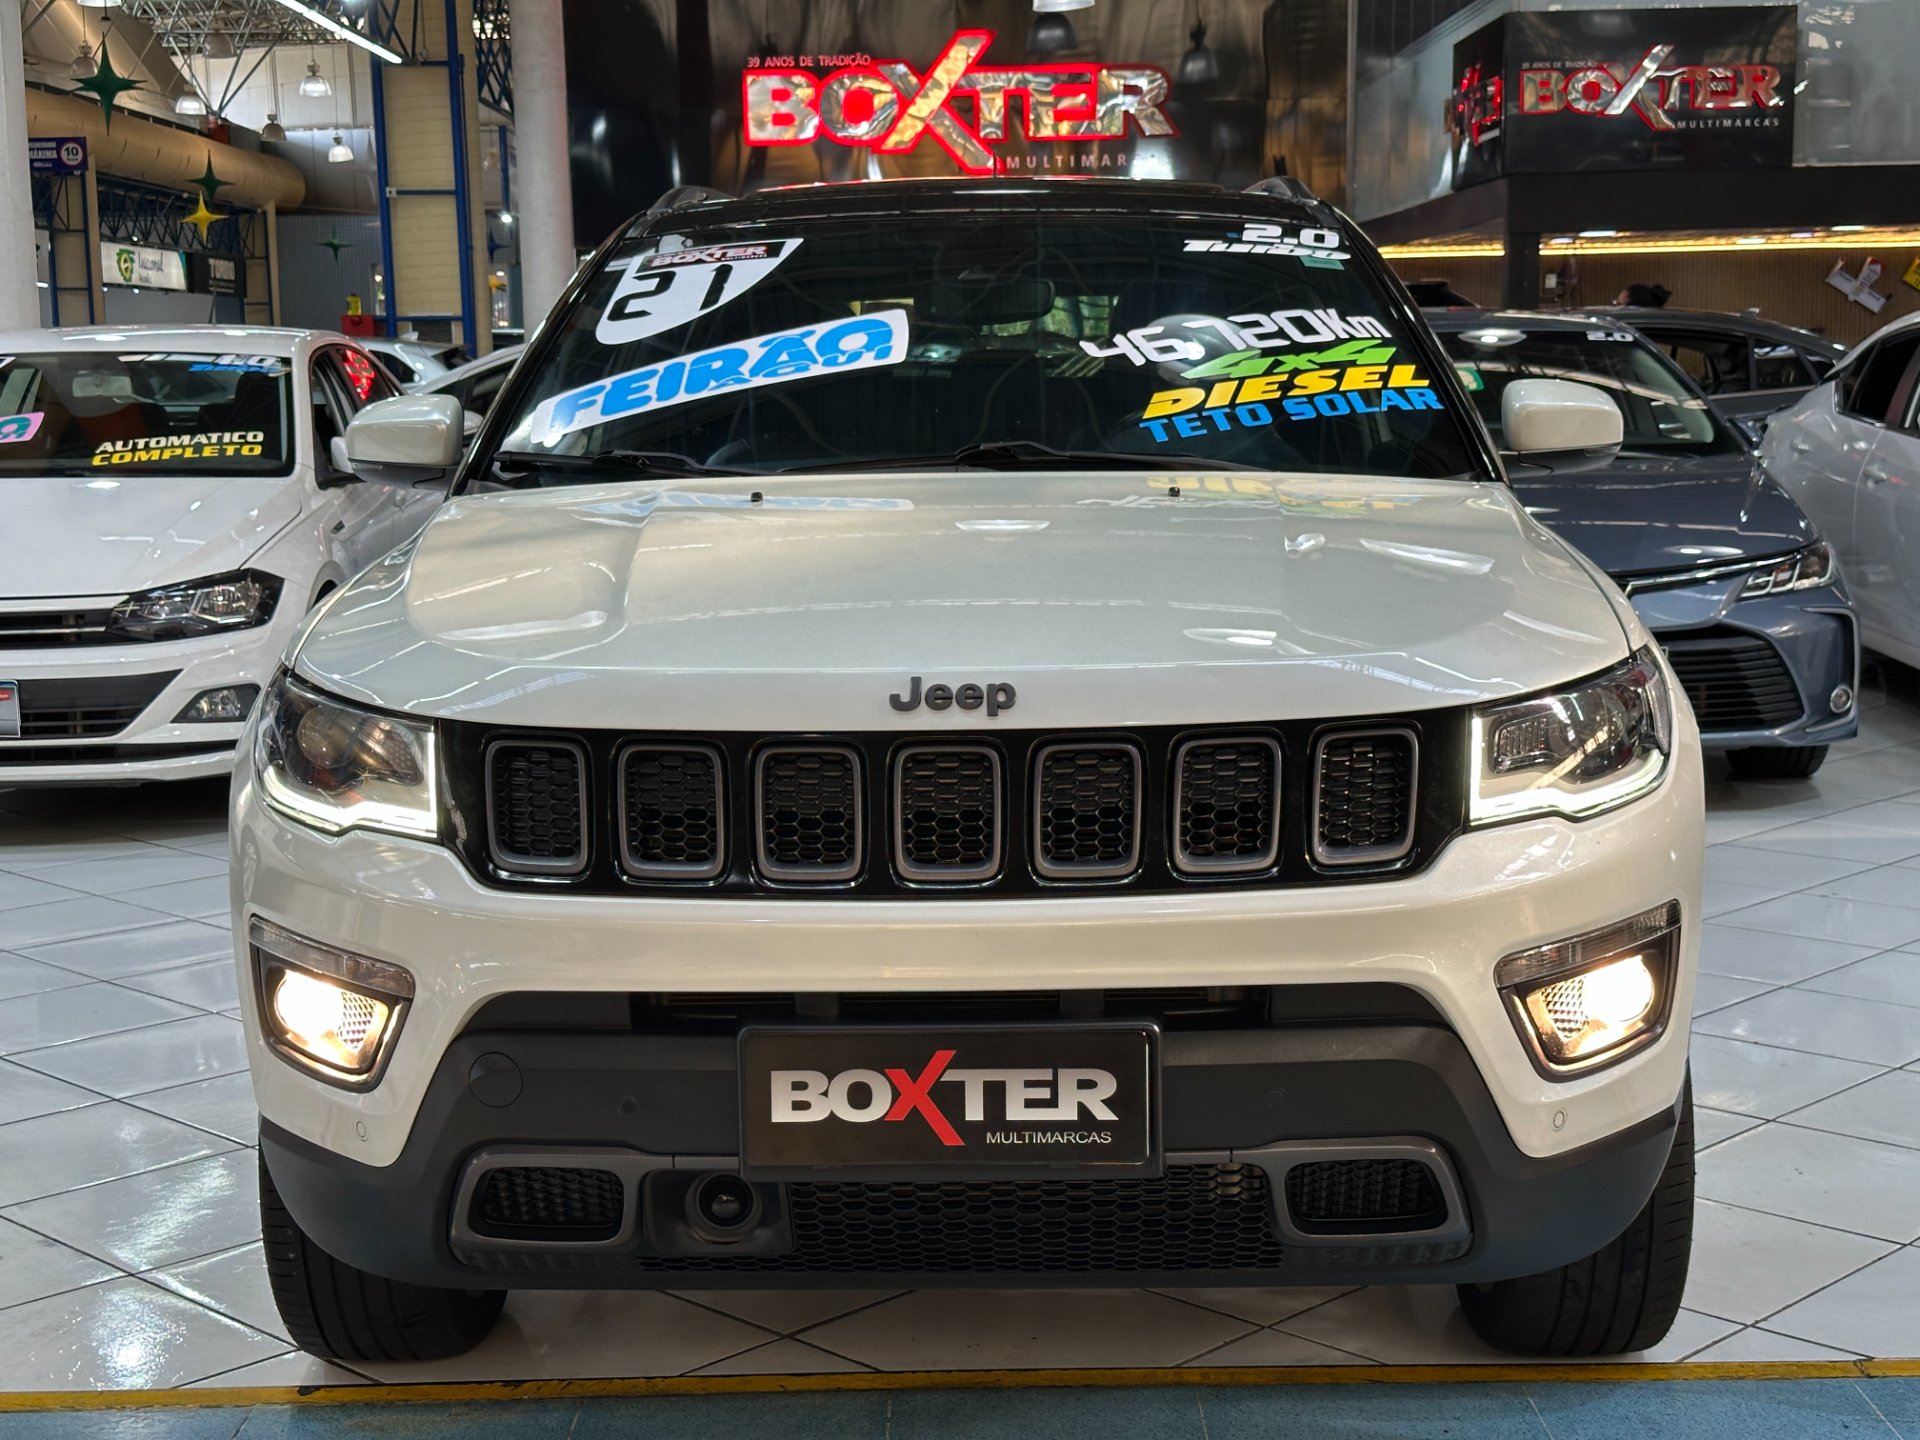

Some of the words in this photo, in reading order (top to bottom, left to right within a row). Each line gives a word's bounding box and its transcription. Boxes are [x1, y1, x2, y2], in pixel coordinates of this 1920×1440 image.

[747, 56, 760, 68] 39
[764, 56, 795, 68] ANOS
[799, 56, 814, 67] DE
[818, 52, 871, 68] TRADIÇÃO
[743, 28, 1181, 176] BOXTER
[1519, 44, 1786, 132] BOXTER
[1676, 118, 1780, 129] MULTIMARCAS
[64, 146, 79, 157] 10
[1242, 223, 1340, 248] 2.0
[651, 245, 768, 268] BOXTER
[607, 264, 733, 322] 21
[550, 318, 893, 430] FEIRÃO
[707, 344, 893, 391] AQUI
[1180, 339, 1396, 379] 4x4
[1142, 364, 1430, 420] DIESEL
[1139, 403, 1273, 443] TETO
[1282, 388, 1445, 421] SOLAR
[92, 444, 262, 466] COMPLETO
[95, 431, 265, 454] AUTOMATICO
[889, 676, 1017, 717] Jeep
[770, 1050, 1119, 1146] BOXTER
[986, 1131, 1112, 1144] MULTIMARCAS
